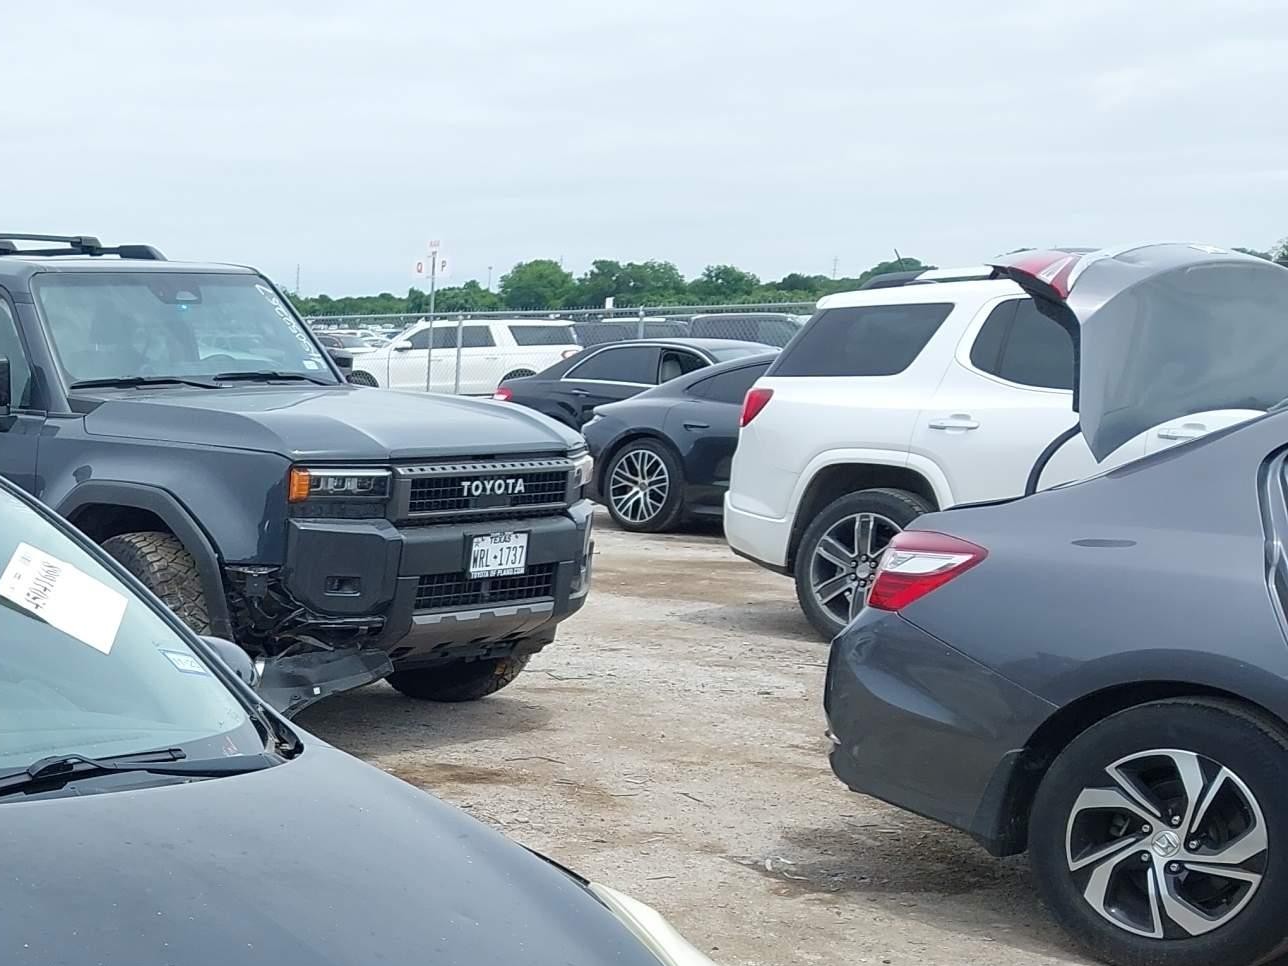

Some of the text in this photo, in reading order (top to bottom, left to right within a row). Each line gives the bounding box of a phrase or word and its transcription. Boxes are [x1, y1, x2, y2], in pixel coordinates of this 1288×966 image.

[441, 260, 447, 272] P
[461, 478, 525, 496] TOYOTA
[490, 534, 512, 544] TEXAS
[24, 560, 61, 610] 45041668
